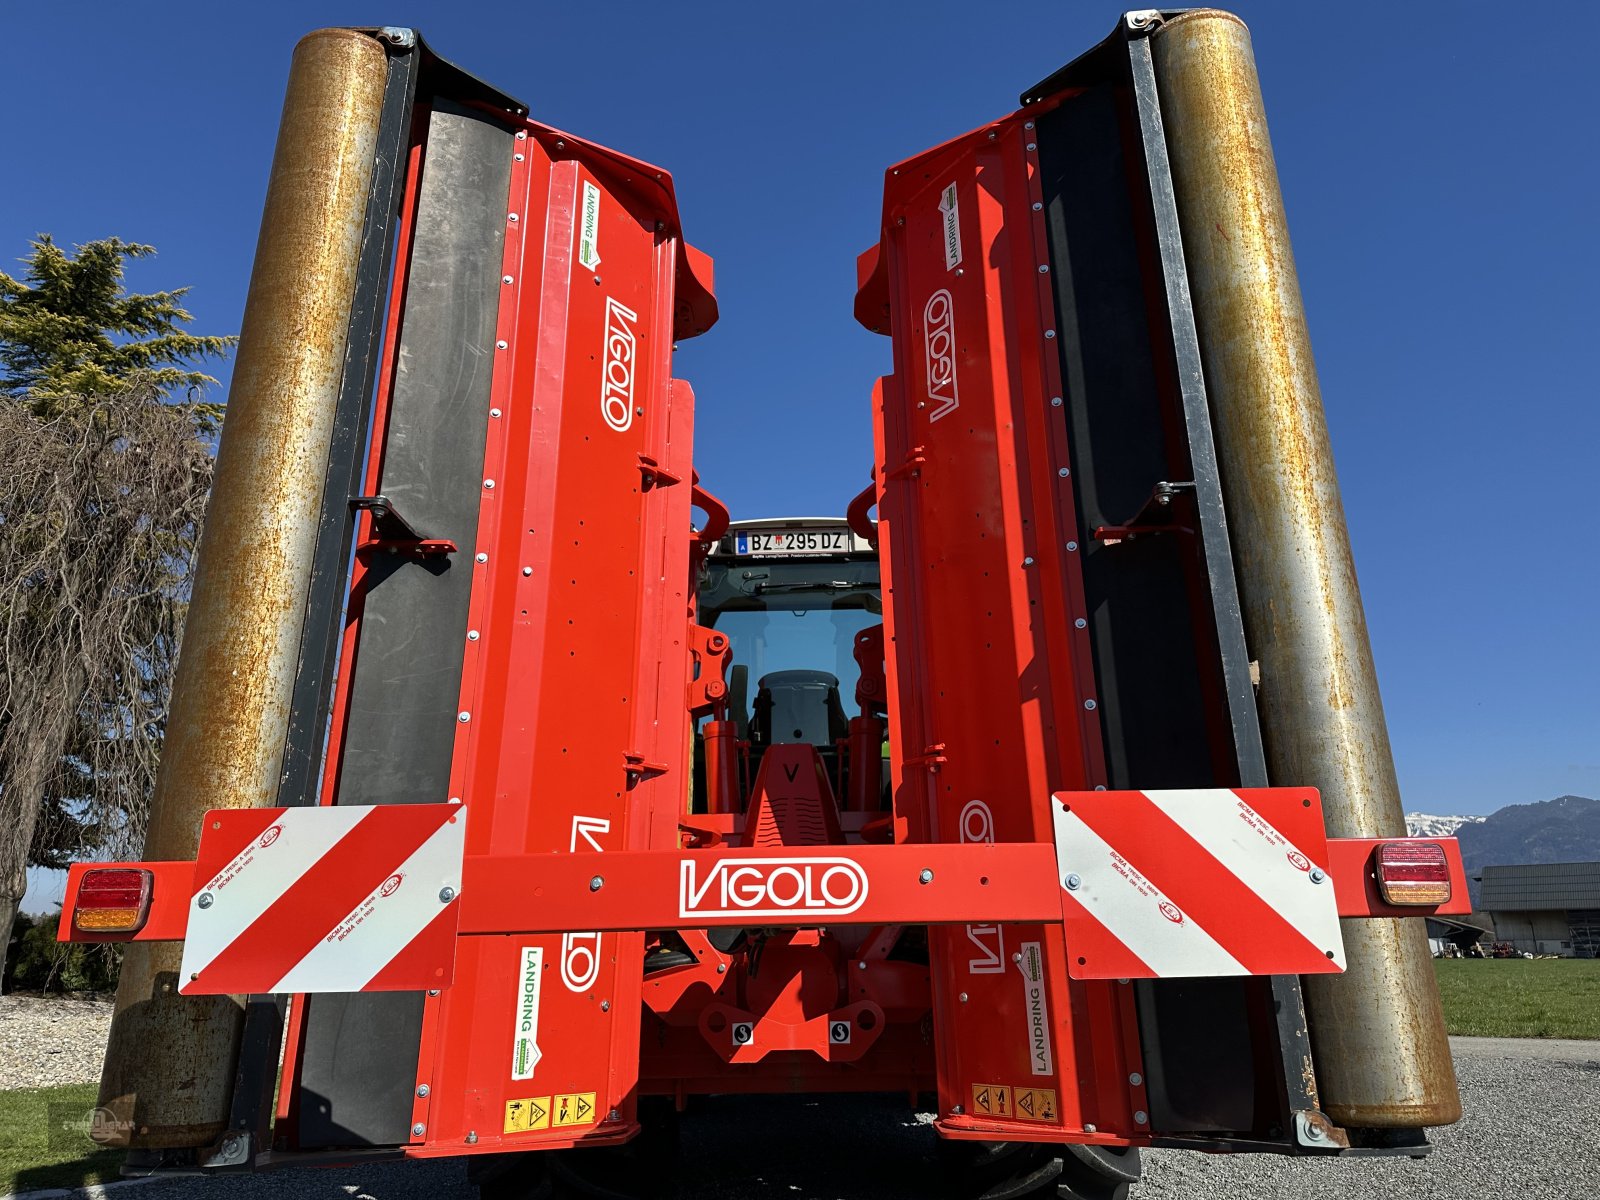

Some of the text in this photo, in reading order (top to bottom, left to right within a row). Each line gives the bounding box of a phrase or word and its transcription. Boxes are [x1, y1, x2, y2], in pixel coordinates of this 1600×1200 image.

[585, 184, 597, 239] LANDRING
[948, 213, 959, 267] LANDRING
[600, 295, 637, 432] VIGOLO
[923, 288, 959, 423] VIGOLO
[751, 532, 842, 550] BZ 295 DZ
[1237, 801, 1255, 817] BICMA
[1239, 812, 1276, 846] BICMA DIN 11030
[217, 856, 254, 890] BICMA DIN 11030
[1110, 851, 1127, 868] BICMA
[207, 874, 223, 891] BICMA
[679, 857, 869, 918] VIGOLO
[1111, 862, 1148, 897] BICMA DIN 11030
[326, 925, 344, 943] BICMA
[337, 906, 375, 942] BICMA DIN 11030
[521, 950, 538, 1032] LANDRING
[1031, 987, 1047, 1072] LANDRING
